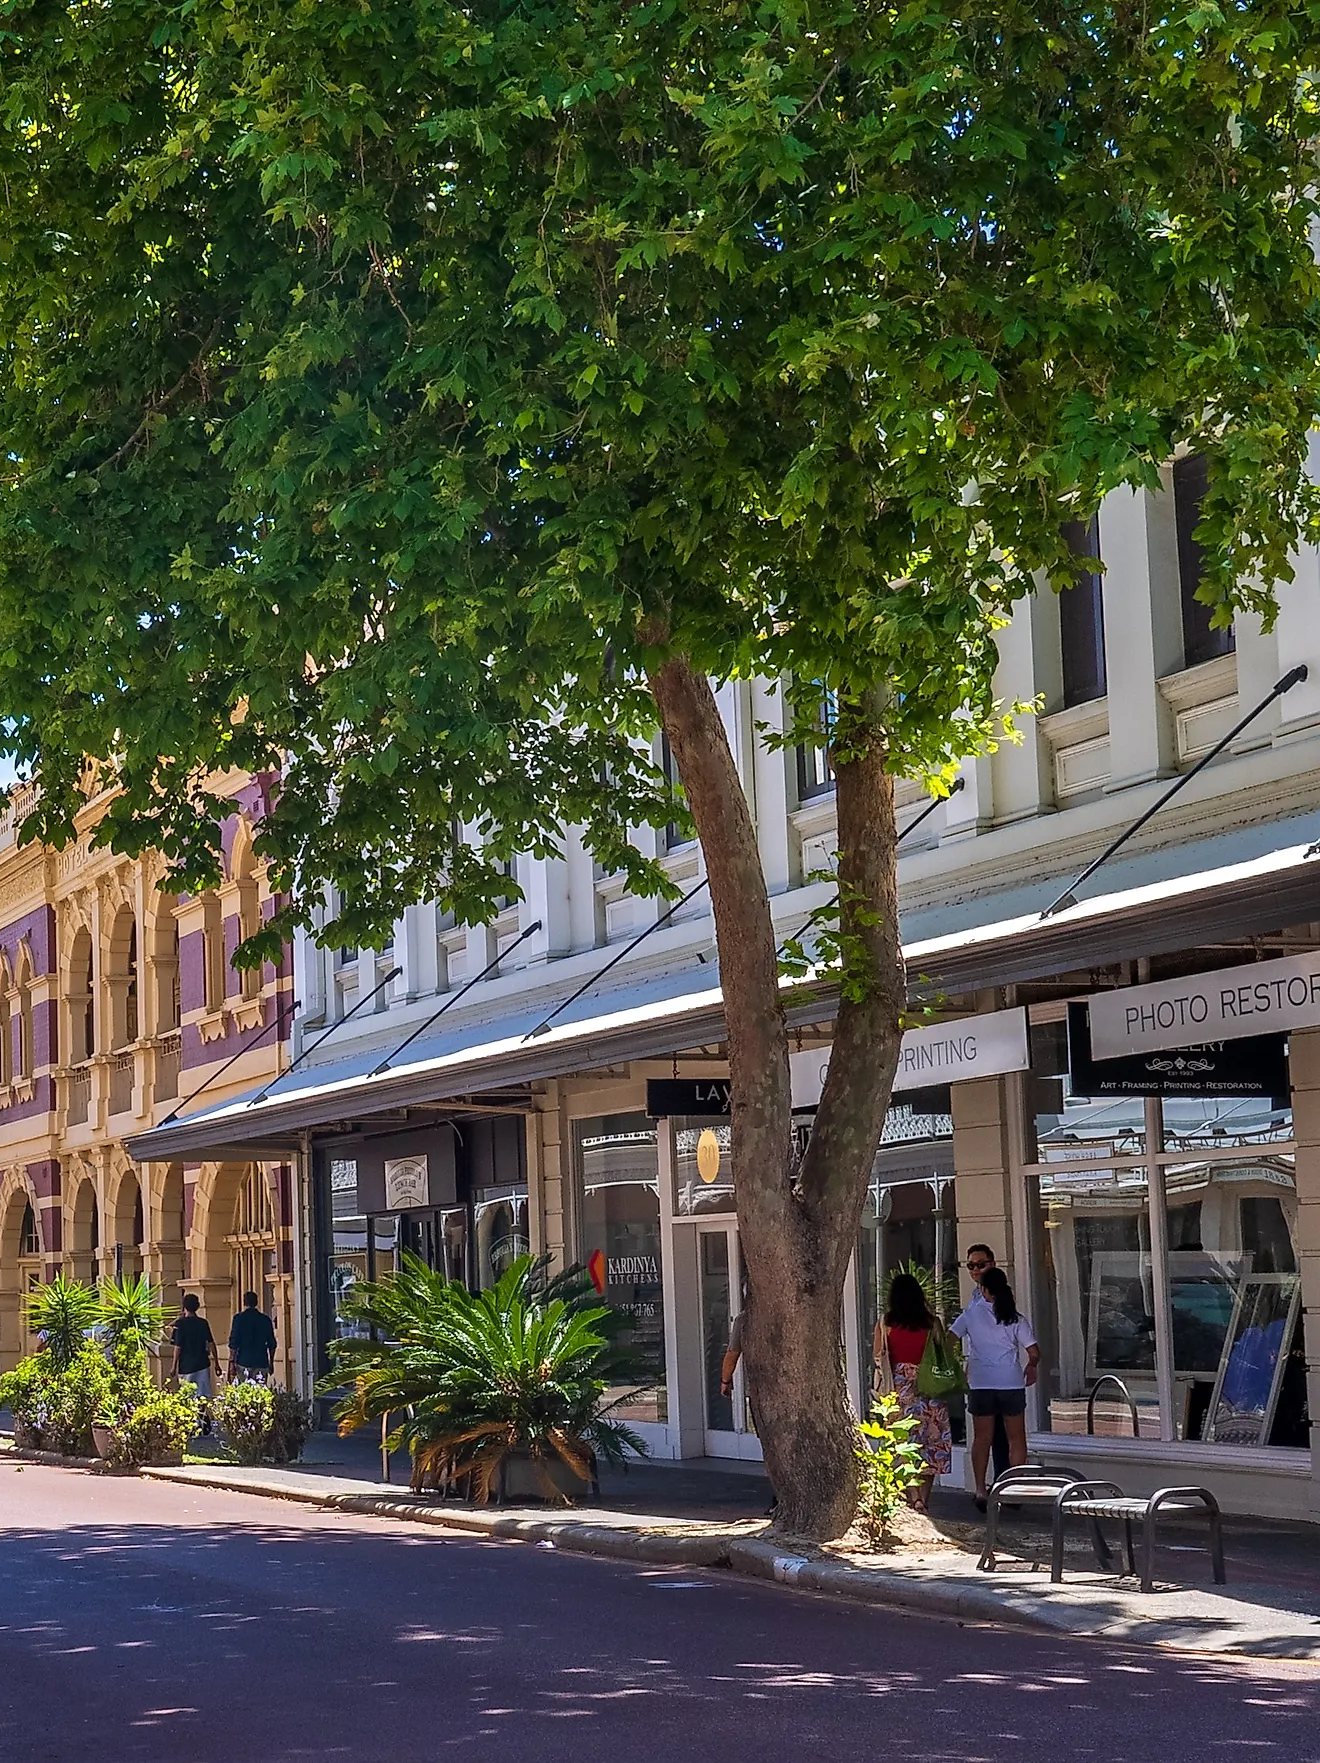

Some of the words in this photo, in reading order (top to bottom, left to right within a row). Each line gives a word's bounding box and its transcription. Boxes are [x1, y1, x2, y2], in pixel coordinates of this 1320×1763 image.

[1125, 994, 1208, 1035] PHOTO
[1100, 1081, 1116, 1090] ART
[1122, 1081, 1159, 1089] FRAMING
[1163, 1081, 1201, 1089] PRINTING
[1206, 1081, 1263, 1090] RESTORATION
[608, 1256, 658, 1275] KARDINYA
[608, 1273, 659, 1285] KITCHENS
